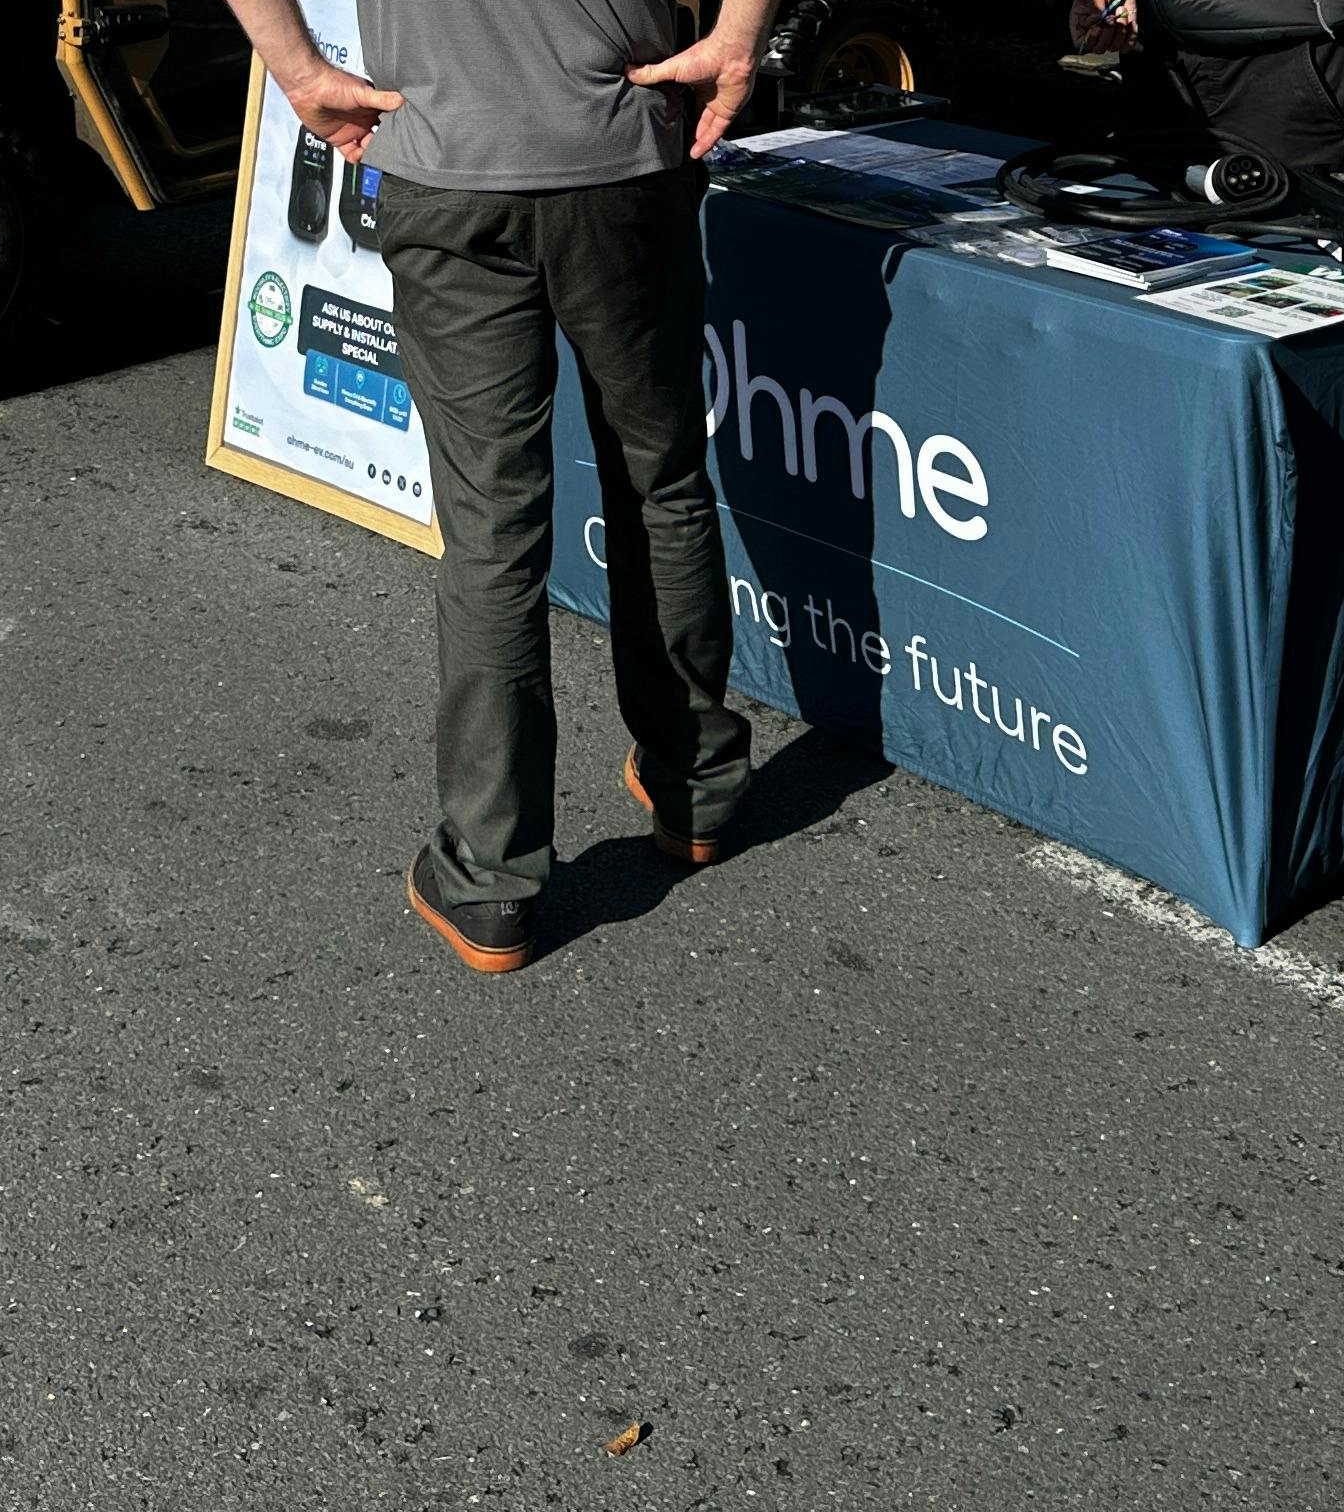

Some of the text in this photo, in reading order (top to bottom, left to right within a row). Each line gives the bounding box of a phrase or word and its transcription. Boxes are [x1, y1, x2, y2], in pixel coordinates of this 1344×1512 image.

[305, 132, 327, 151] Ohme
[312, 315, 399, 355] SUPPLY & INSTALLAT
[322, 302, 396, 337] ASK US ABOUT OU
[342, 342, 379, 365] SPECIAL
[287, 434, 354, 470] ohme-ev.com/au
[803, 594, 1088, 776] the future
